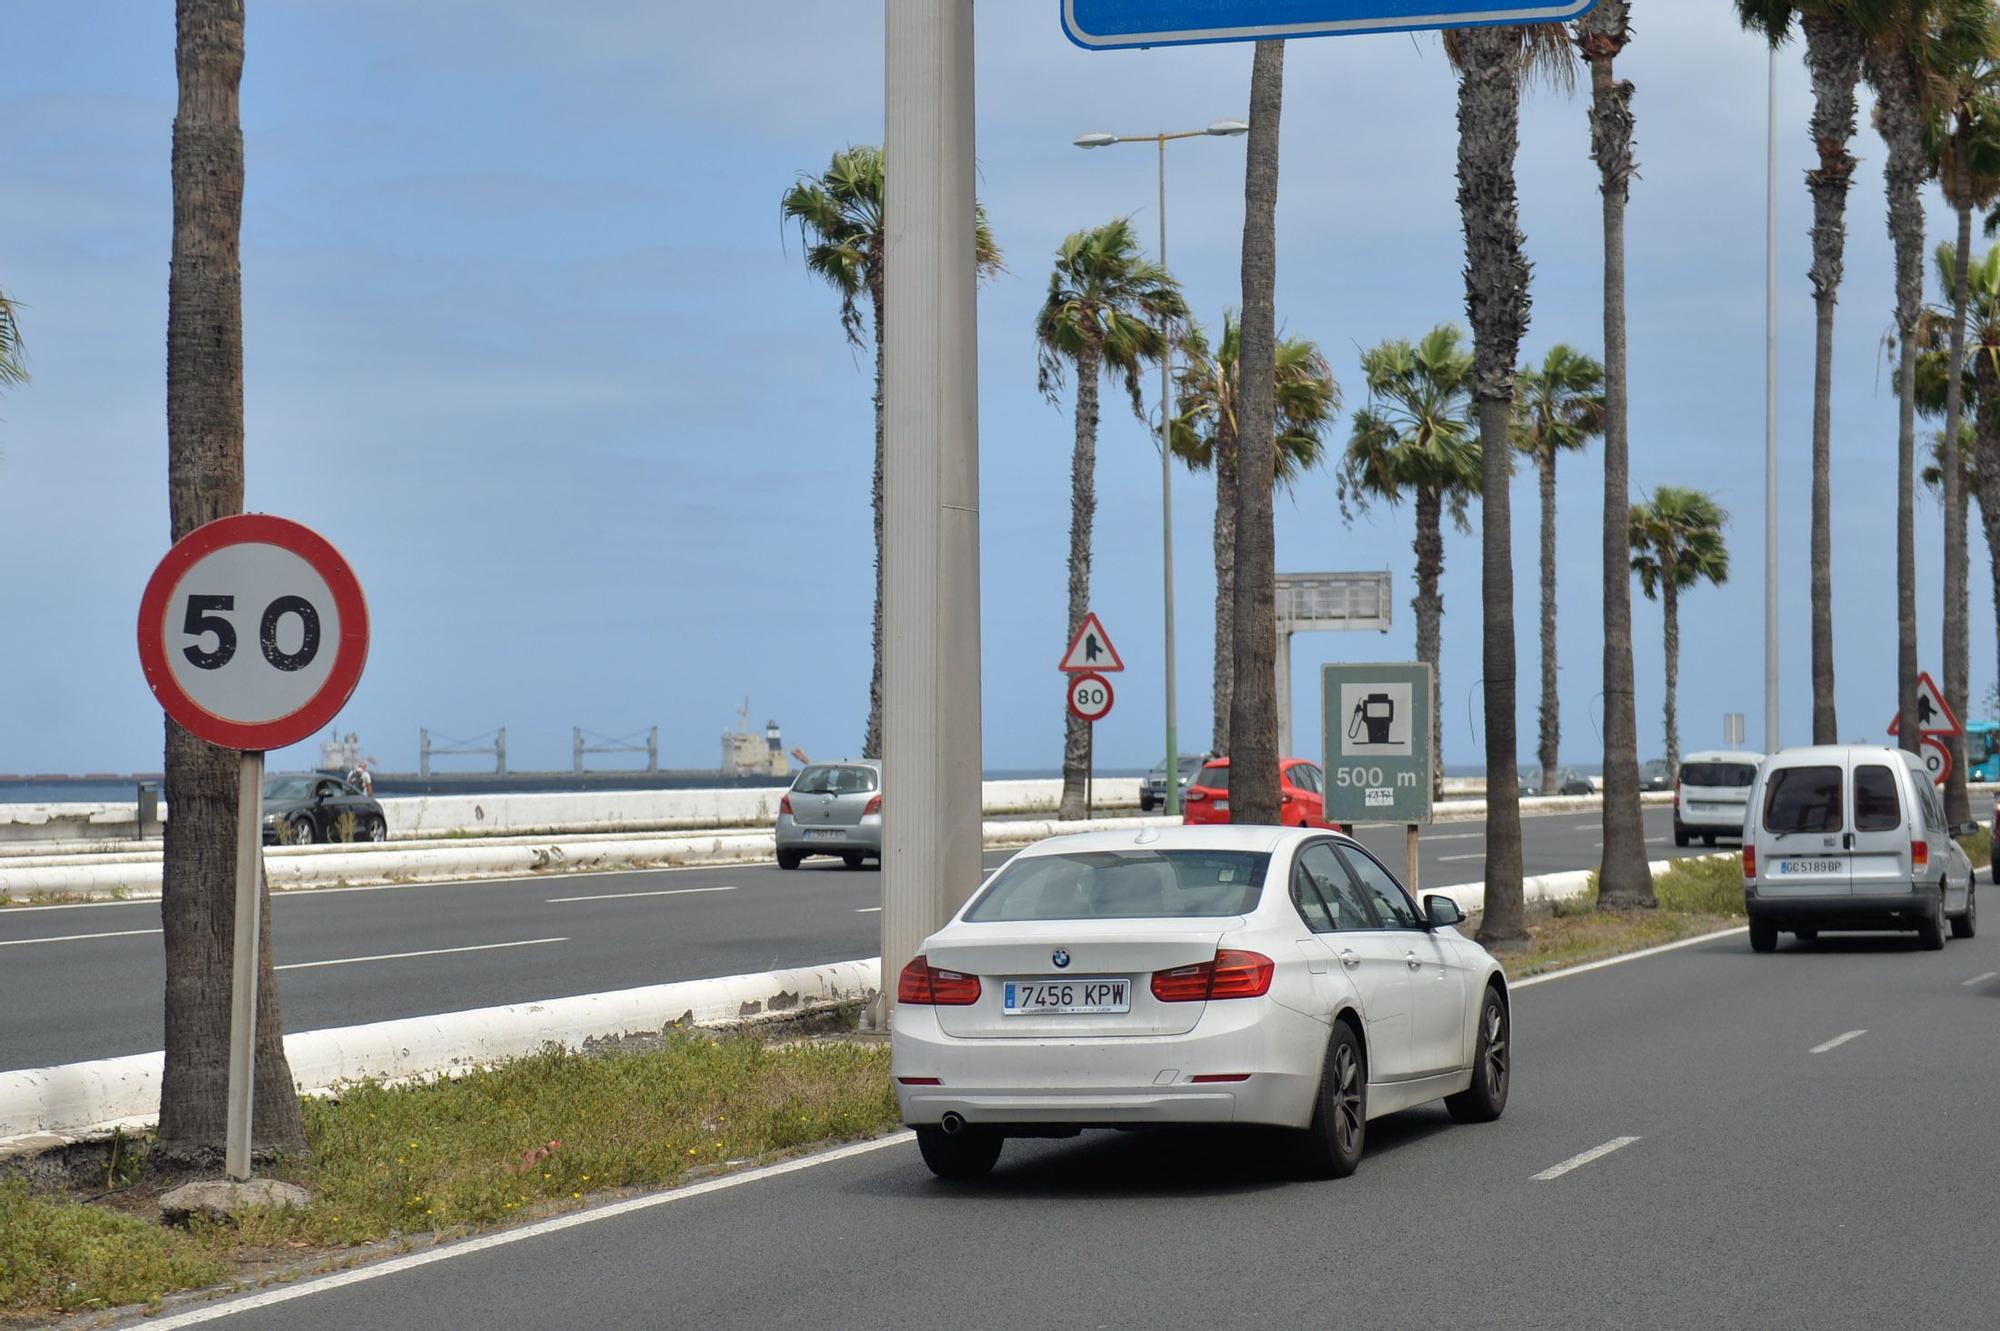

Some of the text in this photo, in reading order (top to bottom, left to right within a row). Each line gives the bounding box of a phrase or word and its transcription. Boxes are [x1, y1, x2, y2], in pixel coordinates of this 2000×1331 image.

[182, 594, 321, 672] 50
[1078, 689, 1104, 705] 80
[1926, 756, 1940, 771] 0
[1336, 766, 1416, 787] 500 m
[1022, 984, 1124, 1007] 7456 KPW
